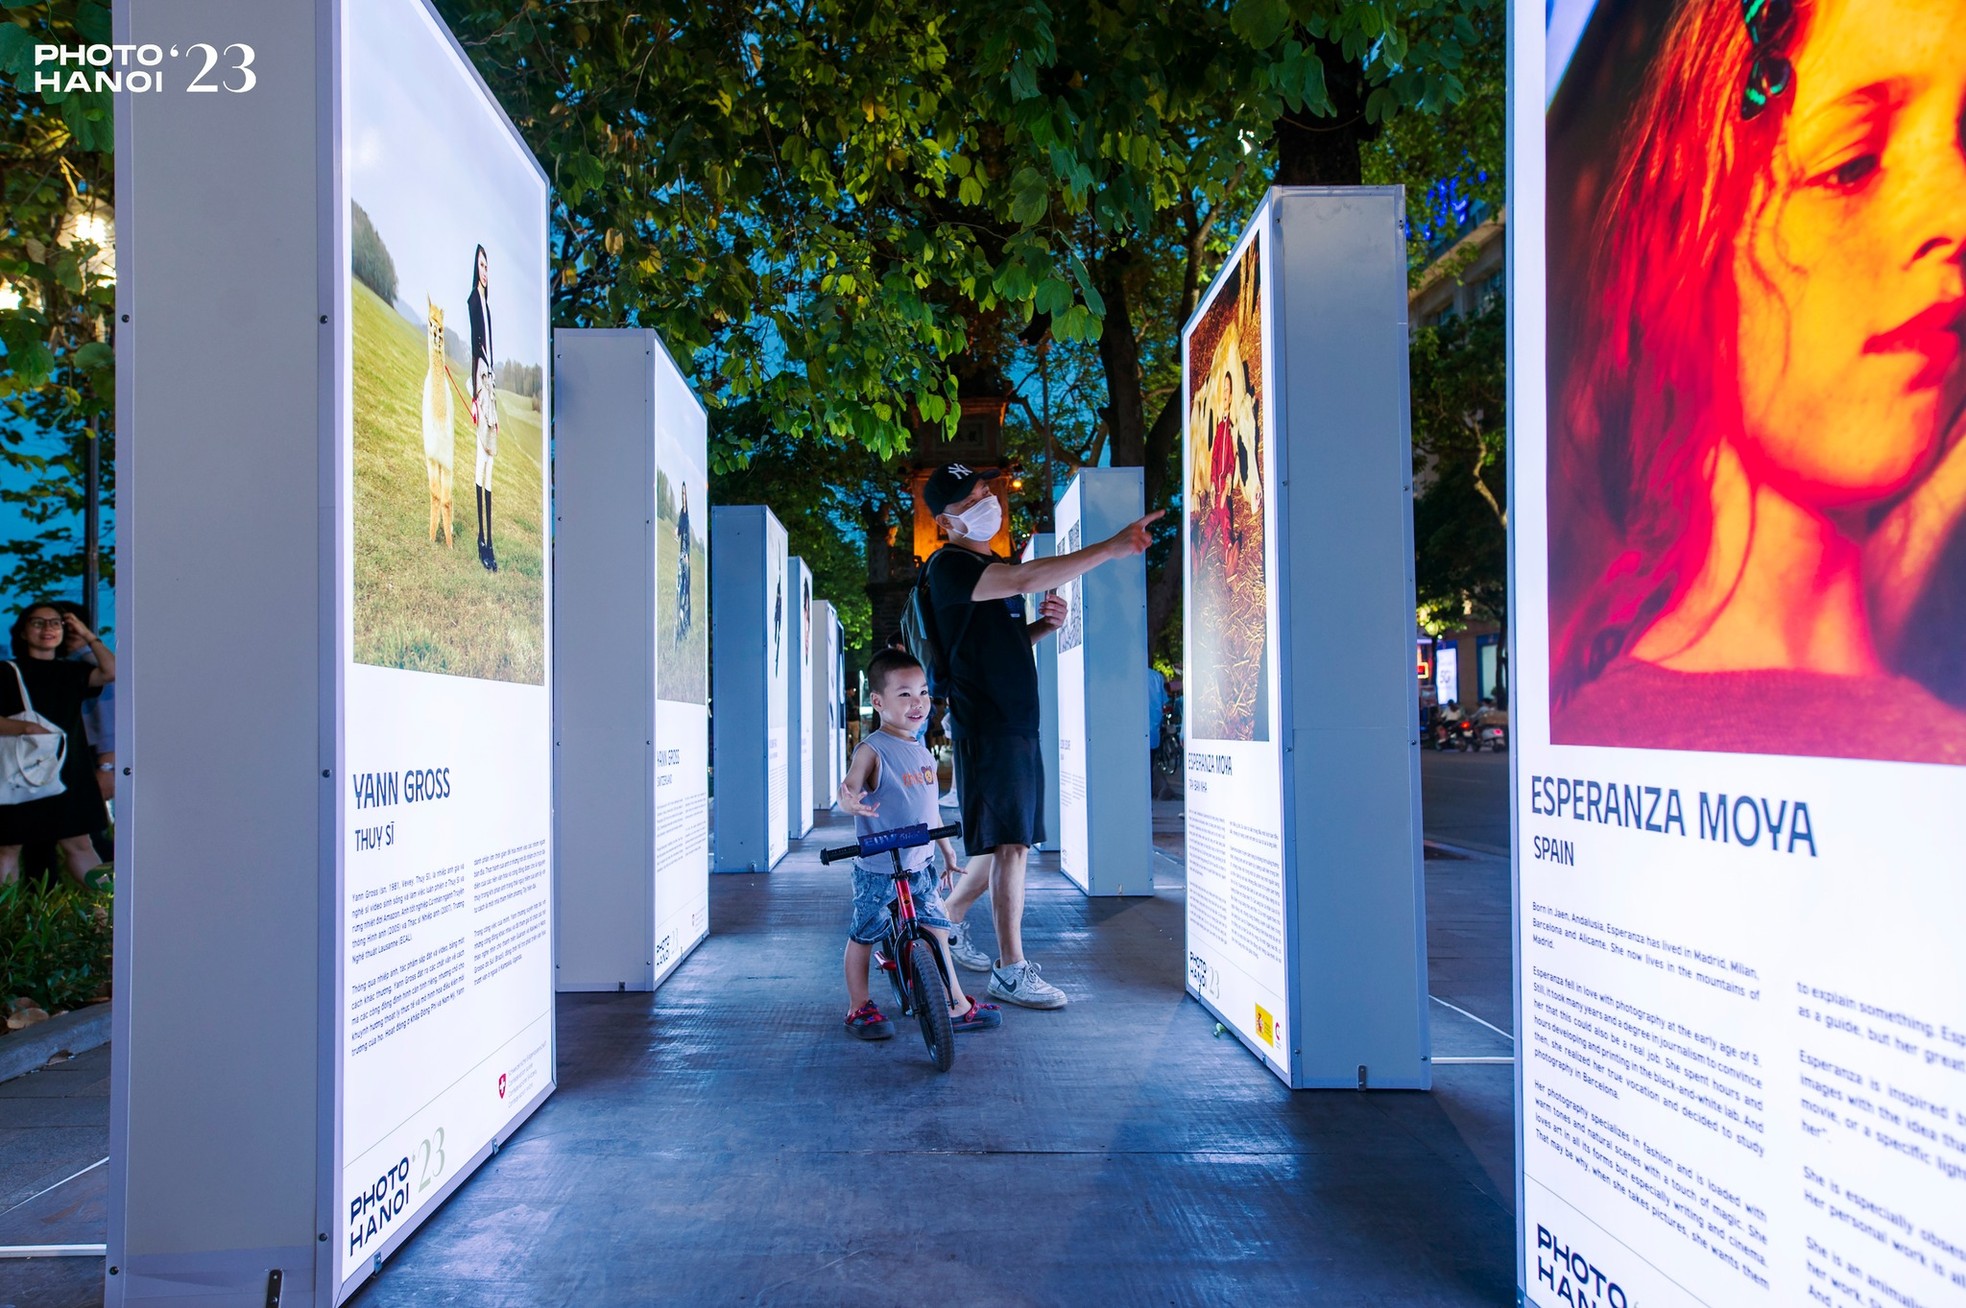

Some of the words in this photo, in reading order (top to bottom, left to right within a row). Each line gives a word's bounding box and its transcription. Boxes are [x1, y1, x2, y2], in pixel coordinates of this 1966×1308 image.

[353, 771, 398, 809] YANN
[404, 767, 450, 803] GROSS
[1216, 755, 1232, 776] MOYA
[1532, 775, 1686, 837] ESPERANZA
[1699, 791, 1818, 857] MOYA
[1533, 835, 1574, 867] SPAIN
[1532, 901, 1545, 913] Born
[1548, 905, 1552, 915] in
[1554, 907, 1571, 922] Jaen,
[1607, 922, 1644, 944] Esperanza
[1646, 935, 1659, 948] has
[1663, 939, 1681, 955] lived
[1684, 946, 1690, 958] in
[1532, 917, 1561, 935] Barcelona
[1564, 929, 1576, 940] and
[1610, 942, 1623, 955] She
[1627, 949, 1641, 961] now
[1646, 953, 1662, 969] lives
[1668, 960, 1673, 972] in
[1678, 965, 1691, 978] the
[1696, 972, 1744, 996] mountains
[1750, 989, 1759, 1000] of
[1532, 965, 1563, 986] Esperanza
[1564, 977, 1574, 990] fell
[1576, 982, 1581, 993] in
[1583, 985, 1597, 999] love
[1599, 993, 1613, 1006] with
[1615, 1000, 1664, 1029] photography
[1667, 1021, 1675, 1032] at
[1677, 1024, 1691, 1038] the
[1694, 1032, 1716, 1050] early
[1719, 1042, 1736, 1057] age
[1739, 1050, 1749, 1061] of
[1533, 1014, 1550, 1030] hours
[1552, 1022, 1586, 1049] developing
[1588, 1041, 1600, 1054] and
[1601, 1047, 1629, 1070] printing
[1632, 1059, 1637, 1072] in
[1639, 1064, 1651, 1079] the
[1654, 1070, 1721, 1113] black-and-white
[1744, 1114, 1763, 1133] And
[1534, 1048, 1572, 1076] photography
[1575, 1066, 1580, 1079] in
[1551, 1039, 1561, 1054] she
[1564, 1046, 1590, 1067] realized
[1593, 1058, 1604, 1073] her
[1607, 1067, 1622, 1083] true
[1626, 1078, 1658, 1102] vocation
[1663, 1096, 1677, 1112] and
[1682, 1105, 1717, 1132] decided
[1722, 1125, 1730, 1138] to
[1737, 1134, 1764, 1157] study
[351, 1156, 409, 1225] PHOTO
[1534, 1078, 1544, 1092] Her
[1547, 1087, 1587, 1119] photography
[1591, 1113, 1629, 1142] specializes
[1633, 1135, 1639, 1148] in
[1643, 1141, 1671, 1167] fashion
[1677, 1163, 1691, 1179] and
[1697, 1171, 1702, 1185] is
[1708, 1178, 1739, 1207] loaded
[1746, 1203, 1766, 1222] with
[1534, 1096, 1550, 1113] warm
[1553, 1105, 1570, 1124] tones
[1573, 1119, 1584, 1133] and
[1587, 1128, 1611, 1150] natural
[1615, 1145, 1640, 1167] scenes
[1644, 1162, 1659, 1180] with
[1664, 1174, 1667, 1184] a
[1671, 1178, 1695, 1201] touch
[1700, 1197, 1708, 1208] of
[1749, 1224, 1767, 1245] She
[350, 1182, 409, 1257] HANOI
[1535, 1127, 1548, 1144] That
[1550, 1138, 1562, 1155] may
[1565, 1145, 1572, 1160] be
[1592, 1166, 1609, 1185] when
[1613, 1179, 1625, 1194] she
[1628, 1188, 1648, 1210] takes
[1692, 1232, 1706, 1249] she
[1711, 1244, 1738, 1270] wants
[1742, 1263, 1769, 1290] them
[1537, 1223, 1628, 1308] PHOTO
